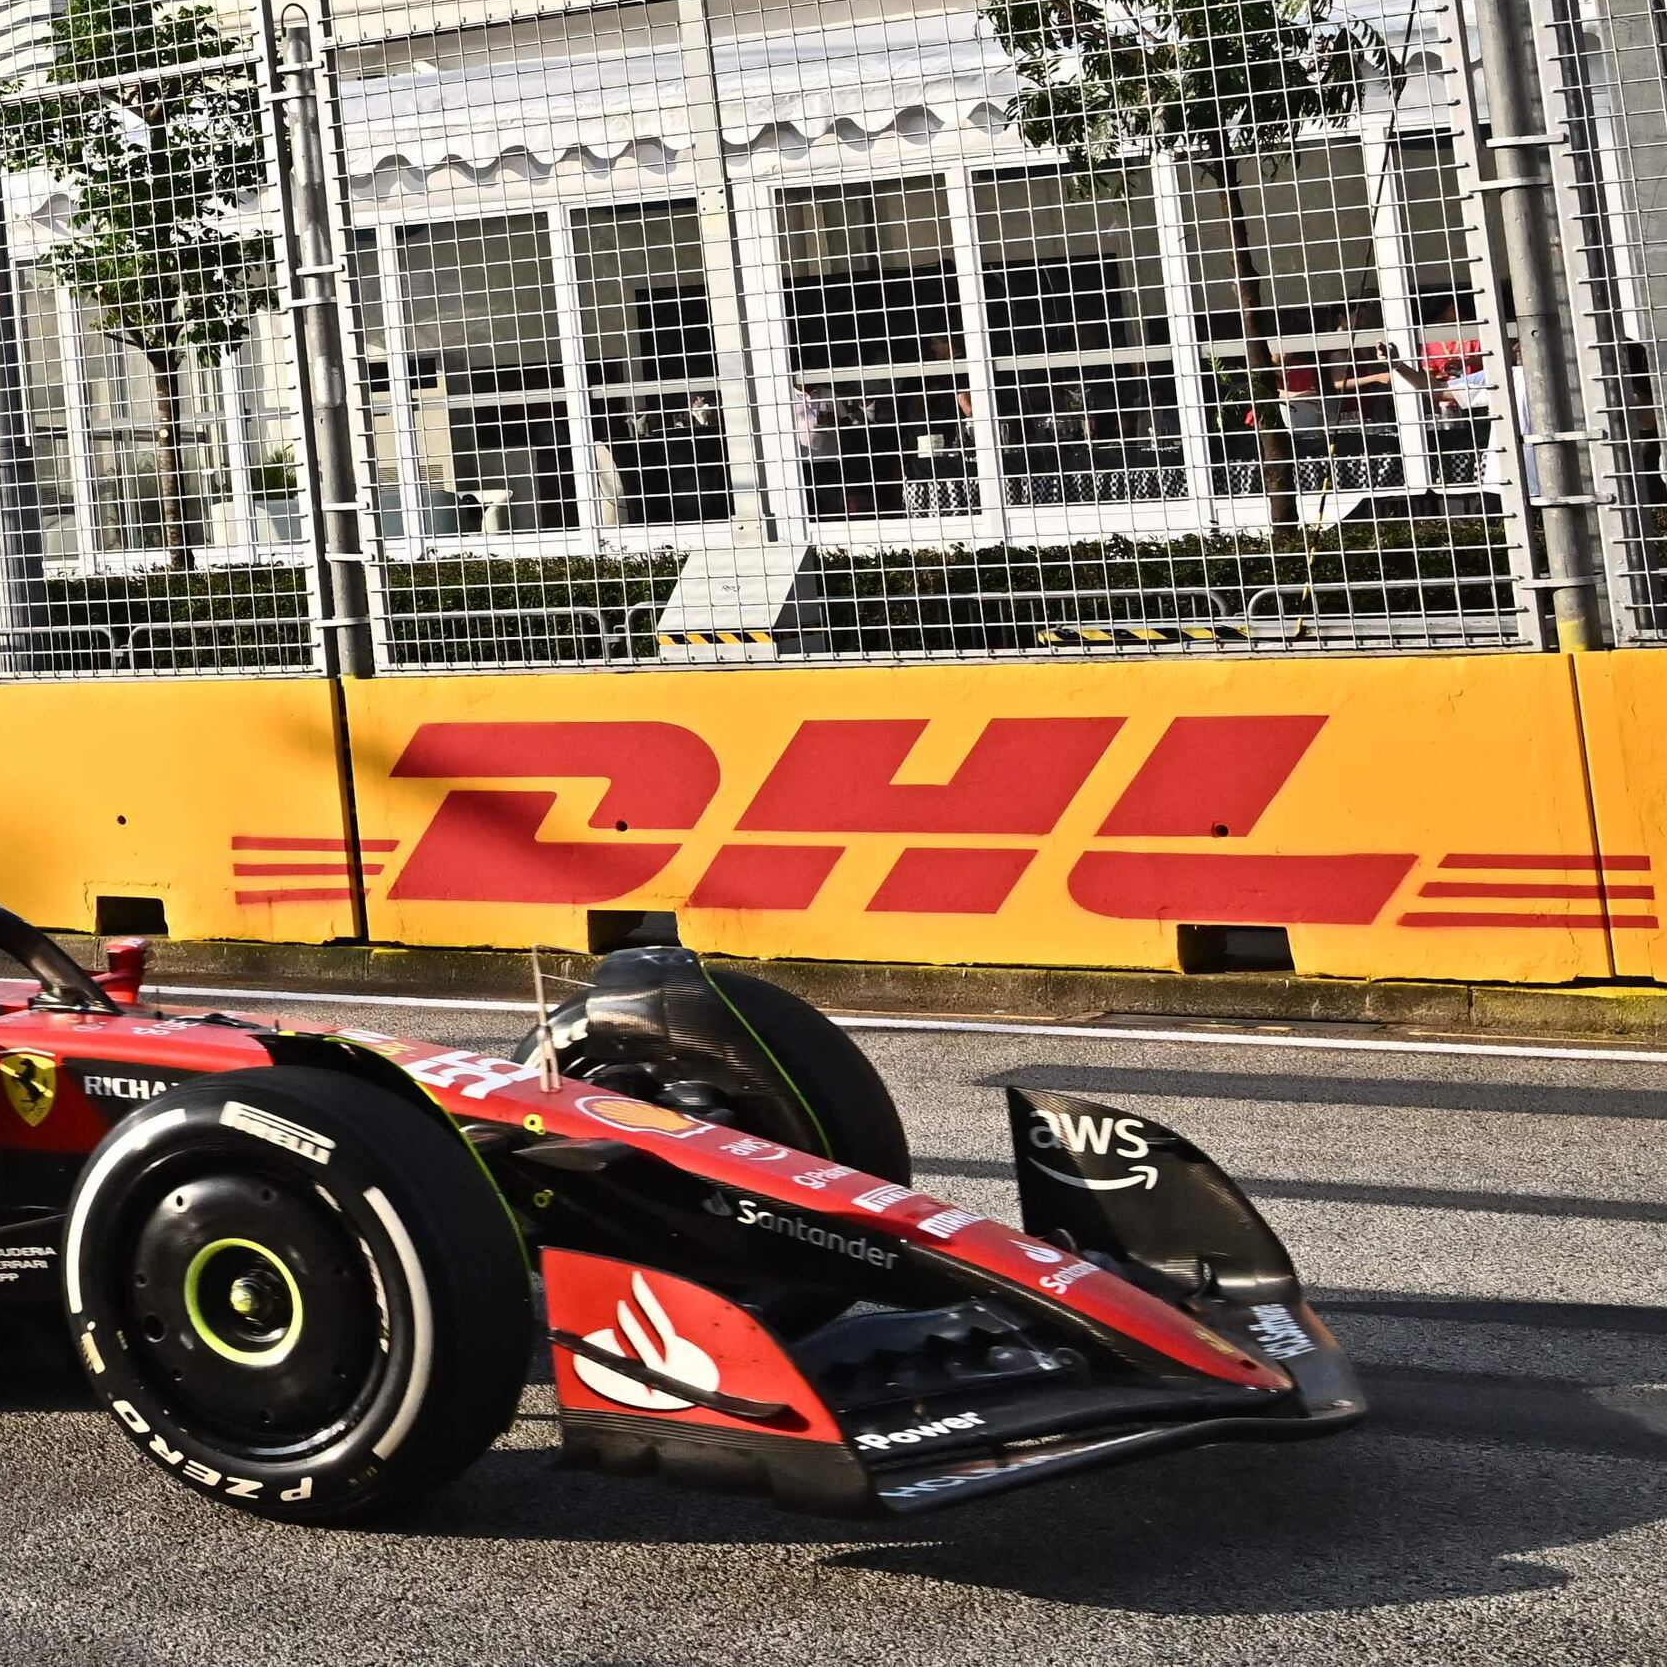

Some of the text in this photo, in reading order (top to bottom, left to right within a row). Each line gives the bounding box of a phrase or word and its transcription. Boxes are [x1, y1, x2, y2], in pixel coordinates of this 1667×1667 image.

[386, 714, 1418, 927] DHL
[85, 1075, 180, 1101] RICHA
[1030, 1110, 1149, 1159] aws
[737, 1199, 898, 1270] Santander
[112, 1399, 313, 1502] P ZERO
